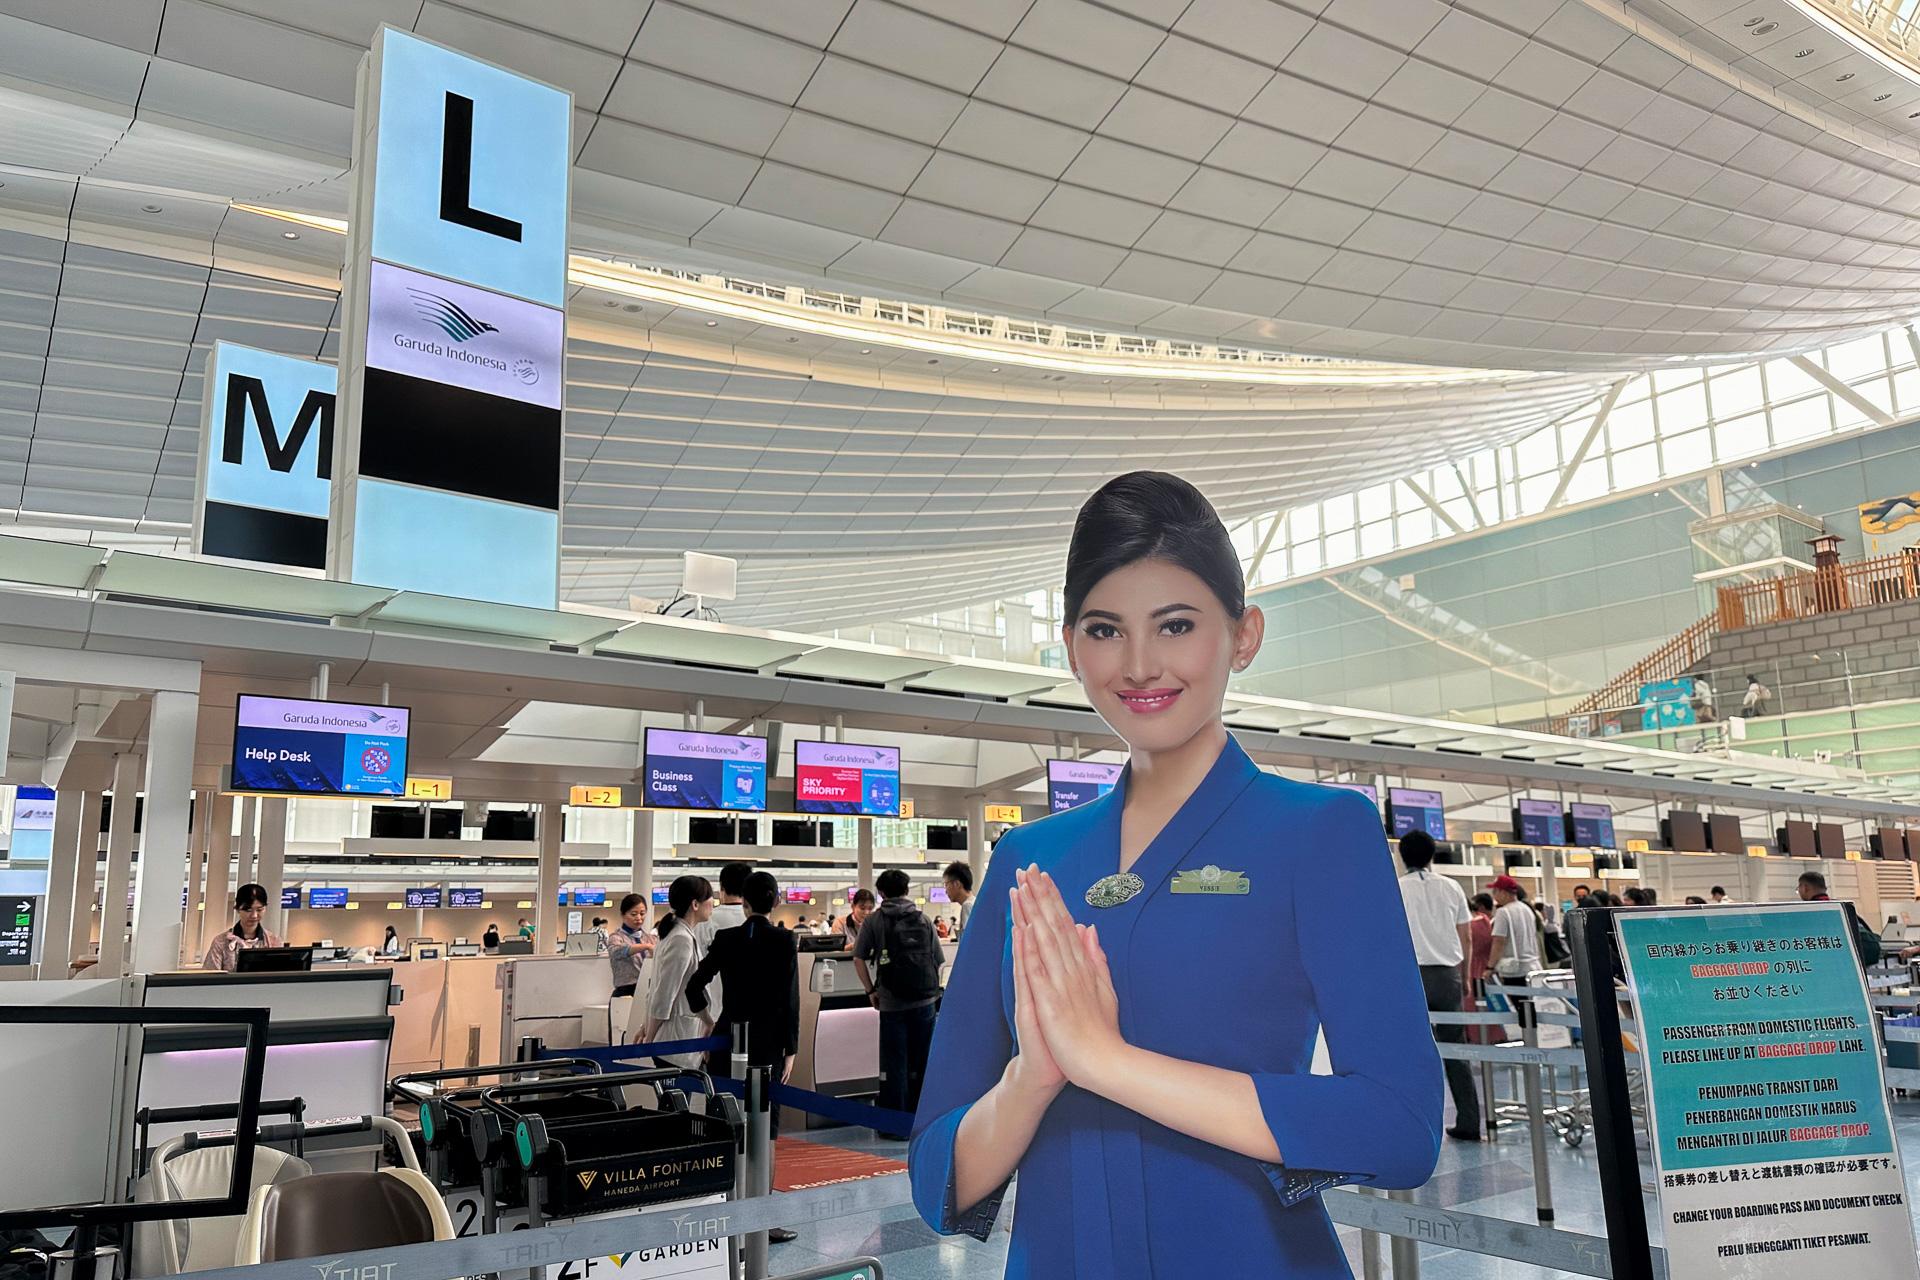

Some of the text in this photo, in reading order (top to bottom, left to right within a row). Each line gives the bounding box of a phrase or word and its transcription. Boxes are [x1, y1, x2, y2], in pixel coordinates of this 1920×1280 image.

[440, 90, 522, 243] L
[394, 333, 507, 371] Garuda Indonesia
[222, 372, 336, 480] M
[283, 712, 367, 729] Garuda Indonesia
[245, 747, 312, 764] Help Desk
[678, 742, 738, 755] Garuda Indonesia
[824, 753, 875, 765] Garuda Indonesia
[652, 769, 693, 782] Business
[803, 778, 822, 787] SKY
[1068, 770, 1108, 780] Garuda Indonesia
[412, 782, 439, 797] L-1
[652, 781, 677, 792] Class
[803, 786, 846, 796] PRIORITY
[585, 790, 611, 804] L-2
[1054, 791, 1079, 801] Transfer
[1055, 800, 1071, 809] Desk
[901, 804, 907, 815] 3
[997, 808, 1015, 820] L-4
[1647, 936, 1842, 959] 国内線からお乗り継ぎのお客様は
[1691, 960, 1812, 979] BAGGAGE DROP の列に
[1712, 984, 1804, 1001] お並びください
[1663, 1024, 1725, 1040] PASSENGER
[1726, 1022, 1756, 1036] FROM
[1758, 1019, 1812, 1035] DOMESTIC
[1663, 1039, 1866, 1064] PLEASE LINE UP AT BAGGAGE DROP LANE.
[1699, 1078, 1838, 1100] PENUMPANG TRANSIT DARI
[1685, 1100, 1857, 1125] PENERBANGAN DOMESTIK HARUS
[1677, 1123, 1872, 1150] MENGANTRI DI JALUR BAGGAGE DROP.
[604, 1156, 724, 1185] VILLA FONTAINE
[1664, 1157, 1898, 1188] 搭乗券の差し替えと渡航書類の確認が必要です。
[604, 1178, 680, 1197] HANEDA AIRPORT
[789, 1174, 871, 1190] Business
[1673, 1193, 1903, 1224] CHANGE YOUR BOARDING PASS AND DOCUMENT CHECK
[638, 1237, 719, 1262] GARDEN
[1717, 1232, 1871, 1258] PERLU MENGGGANTI TIKET PESAWAT.
